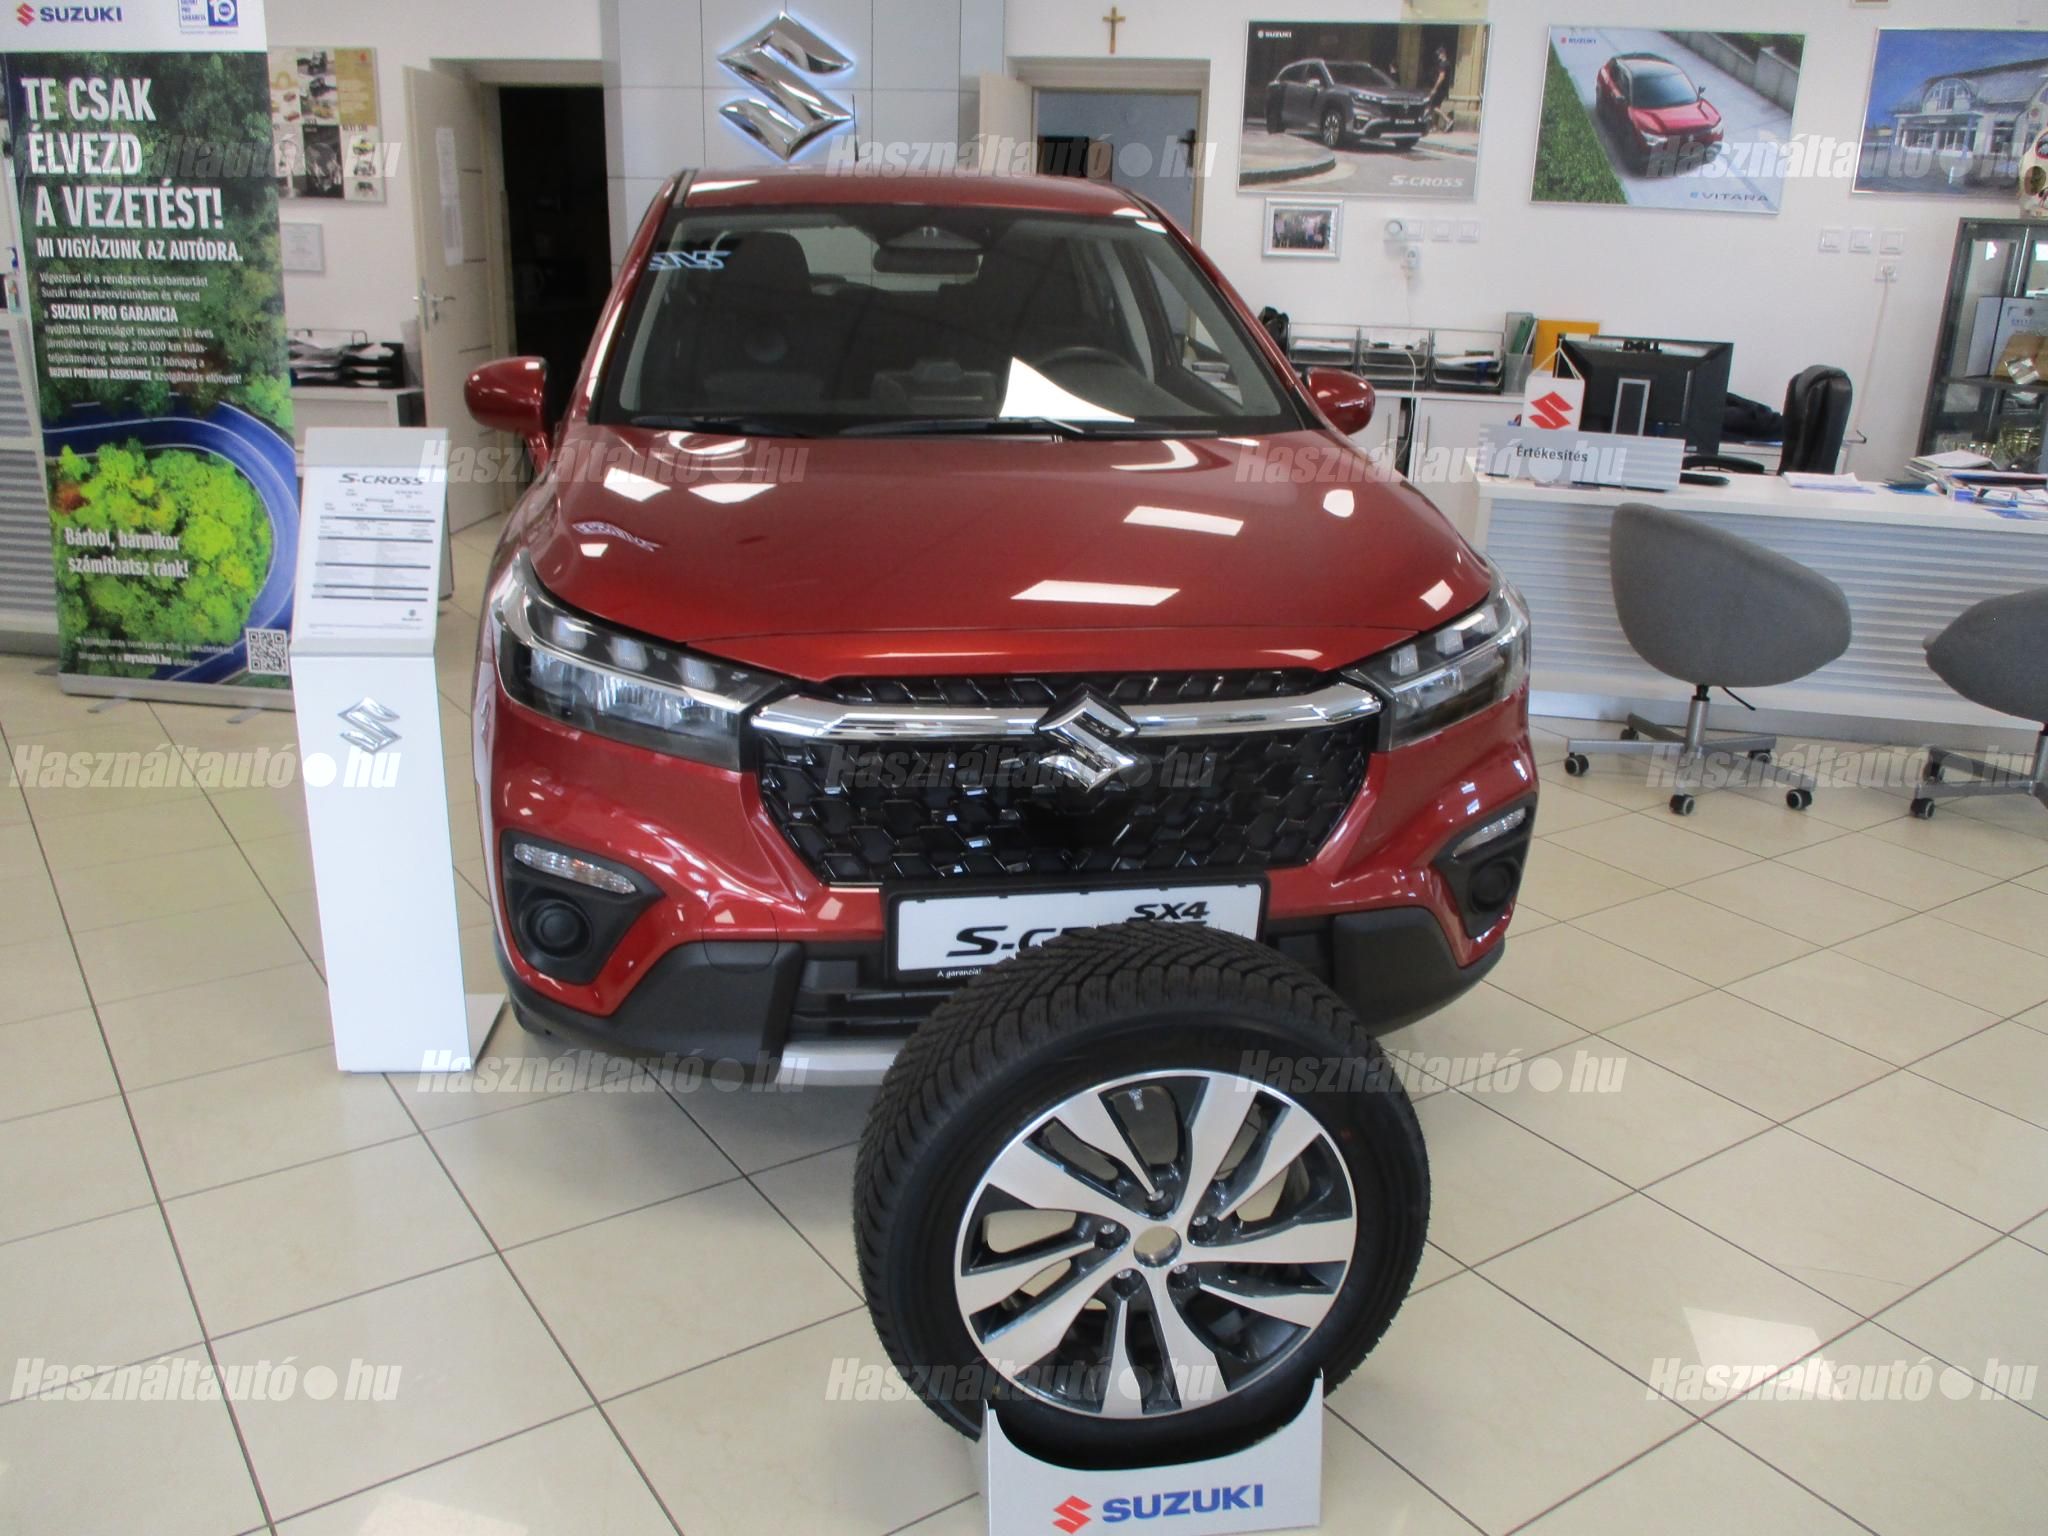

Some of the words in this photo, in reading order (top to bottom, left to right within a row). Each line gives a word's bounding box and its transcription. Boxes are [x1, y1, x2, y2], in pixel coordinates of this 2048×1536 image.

[40, 6, 122, 22] SUZUKI
[20, 78, 59, 121] TE
[67, 76, 156, 121] CSAK
[28, 122, 143, 175] ÉLVEZD
[1389, 174, 1464, 188] S-CROSS
[35, 185, 57, 227] A
[62, 178, 224, 230] VEZETÉST!
[36, 238, 53, 257] MI
[57, 235, 142, 260] VIGYÁZUNK
[147, 240, 166, 260] AZ
[169, 236, 244, 262] AUTÓDRA.
[51, 302, 91, 320] SUZUKI
[93, 304, 118, 321] PRO
[120, 305, 179, 323] GARANCIA
[1622, 340, 1662, 352] DELL
[1515, 445, 1588, 462] Értékesítés
[338, 473, 424, 486] S-CROSS
[64, 527, 115, 551] Bárhol,
[117, 529, 179, 551] bármikor
[67, 554, 150, 576] számíthatsz
[153, 558, 189, 578] ránk!
[1126, 901, 1209, 923] SX4
[937, 969, 944, 978] A
[1102, 1484, 1263, 1524] SUZUKI
